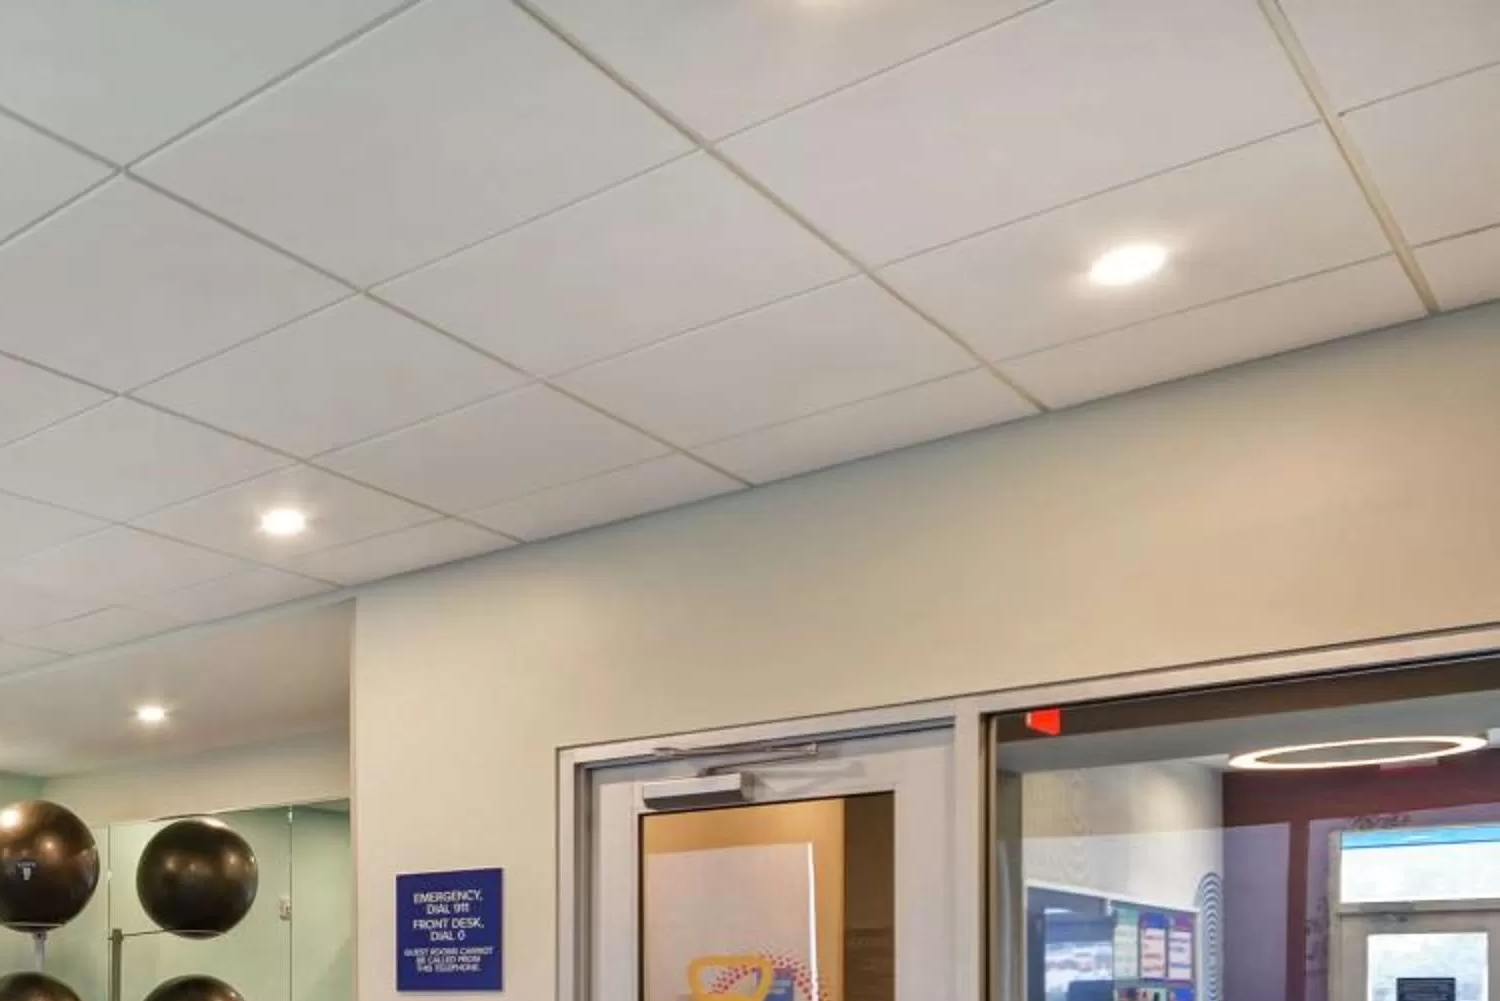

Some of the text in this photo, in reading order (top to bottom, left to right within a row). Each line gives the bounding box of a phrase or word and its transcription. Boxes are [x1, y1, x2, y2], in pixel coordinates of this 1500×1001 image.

[426, 902, 470, 914] DIAL 911
[413, 918, 449, 930] FRONT
[430, 931, 455, 942] DIAL
